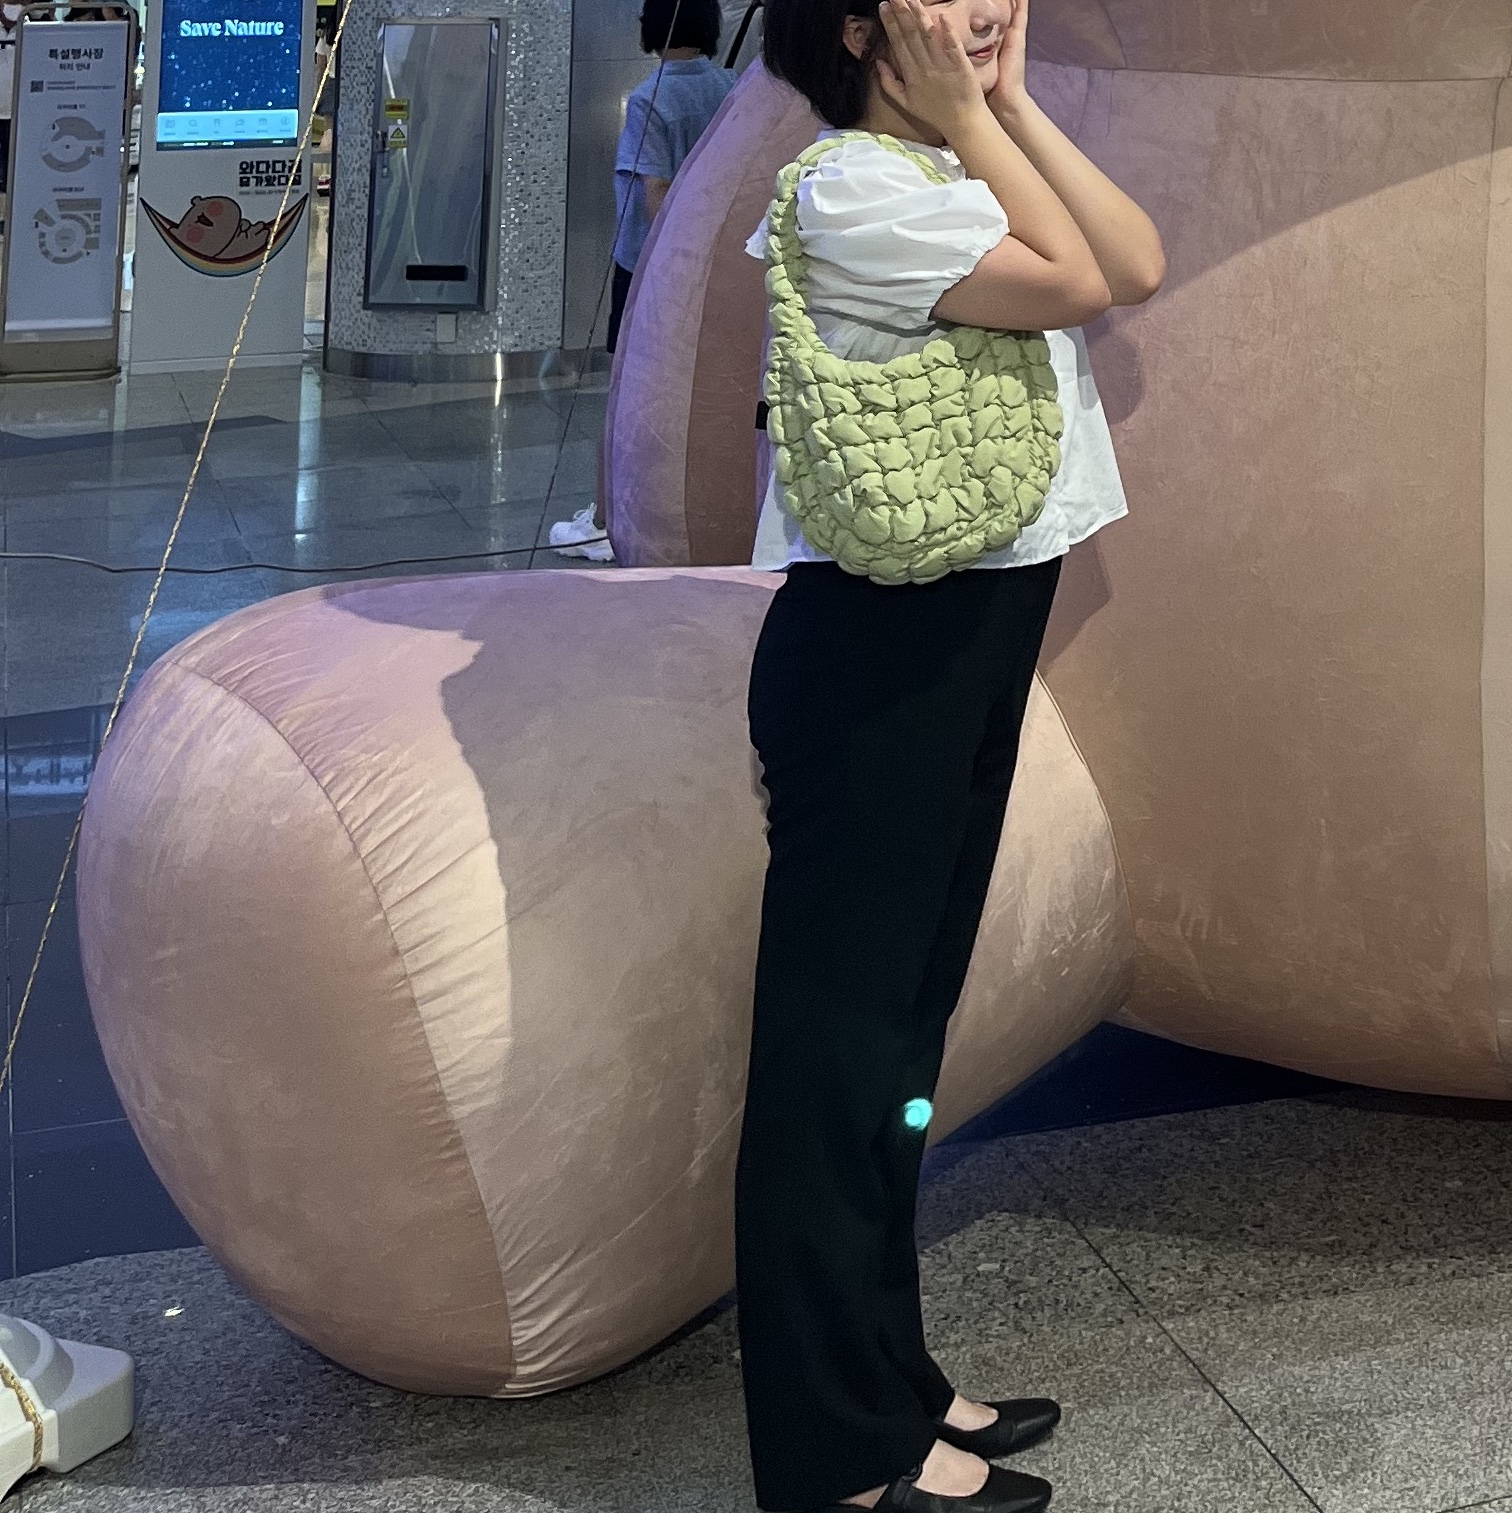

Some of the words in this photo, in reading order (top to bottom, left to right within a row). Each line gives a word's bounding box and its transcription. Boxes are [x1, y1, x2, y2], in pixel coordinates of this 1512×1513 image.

[180, 20, 221, 37] Save
[224, 19, 284, 36] Nature
[48, 47, 104, 60] 특설행사장
